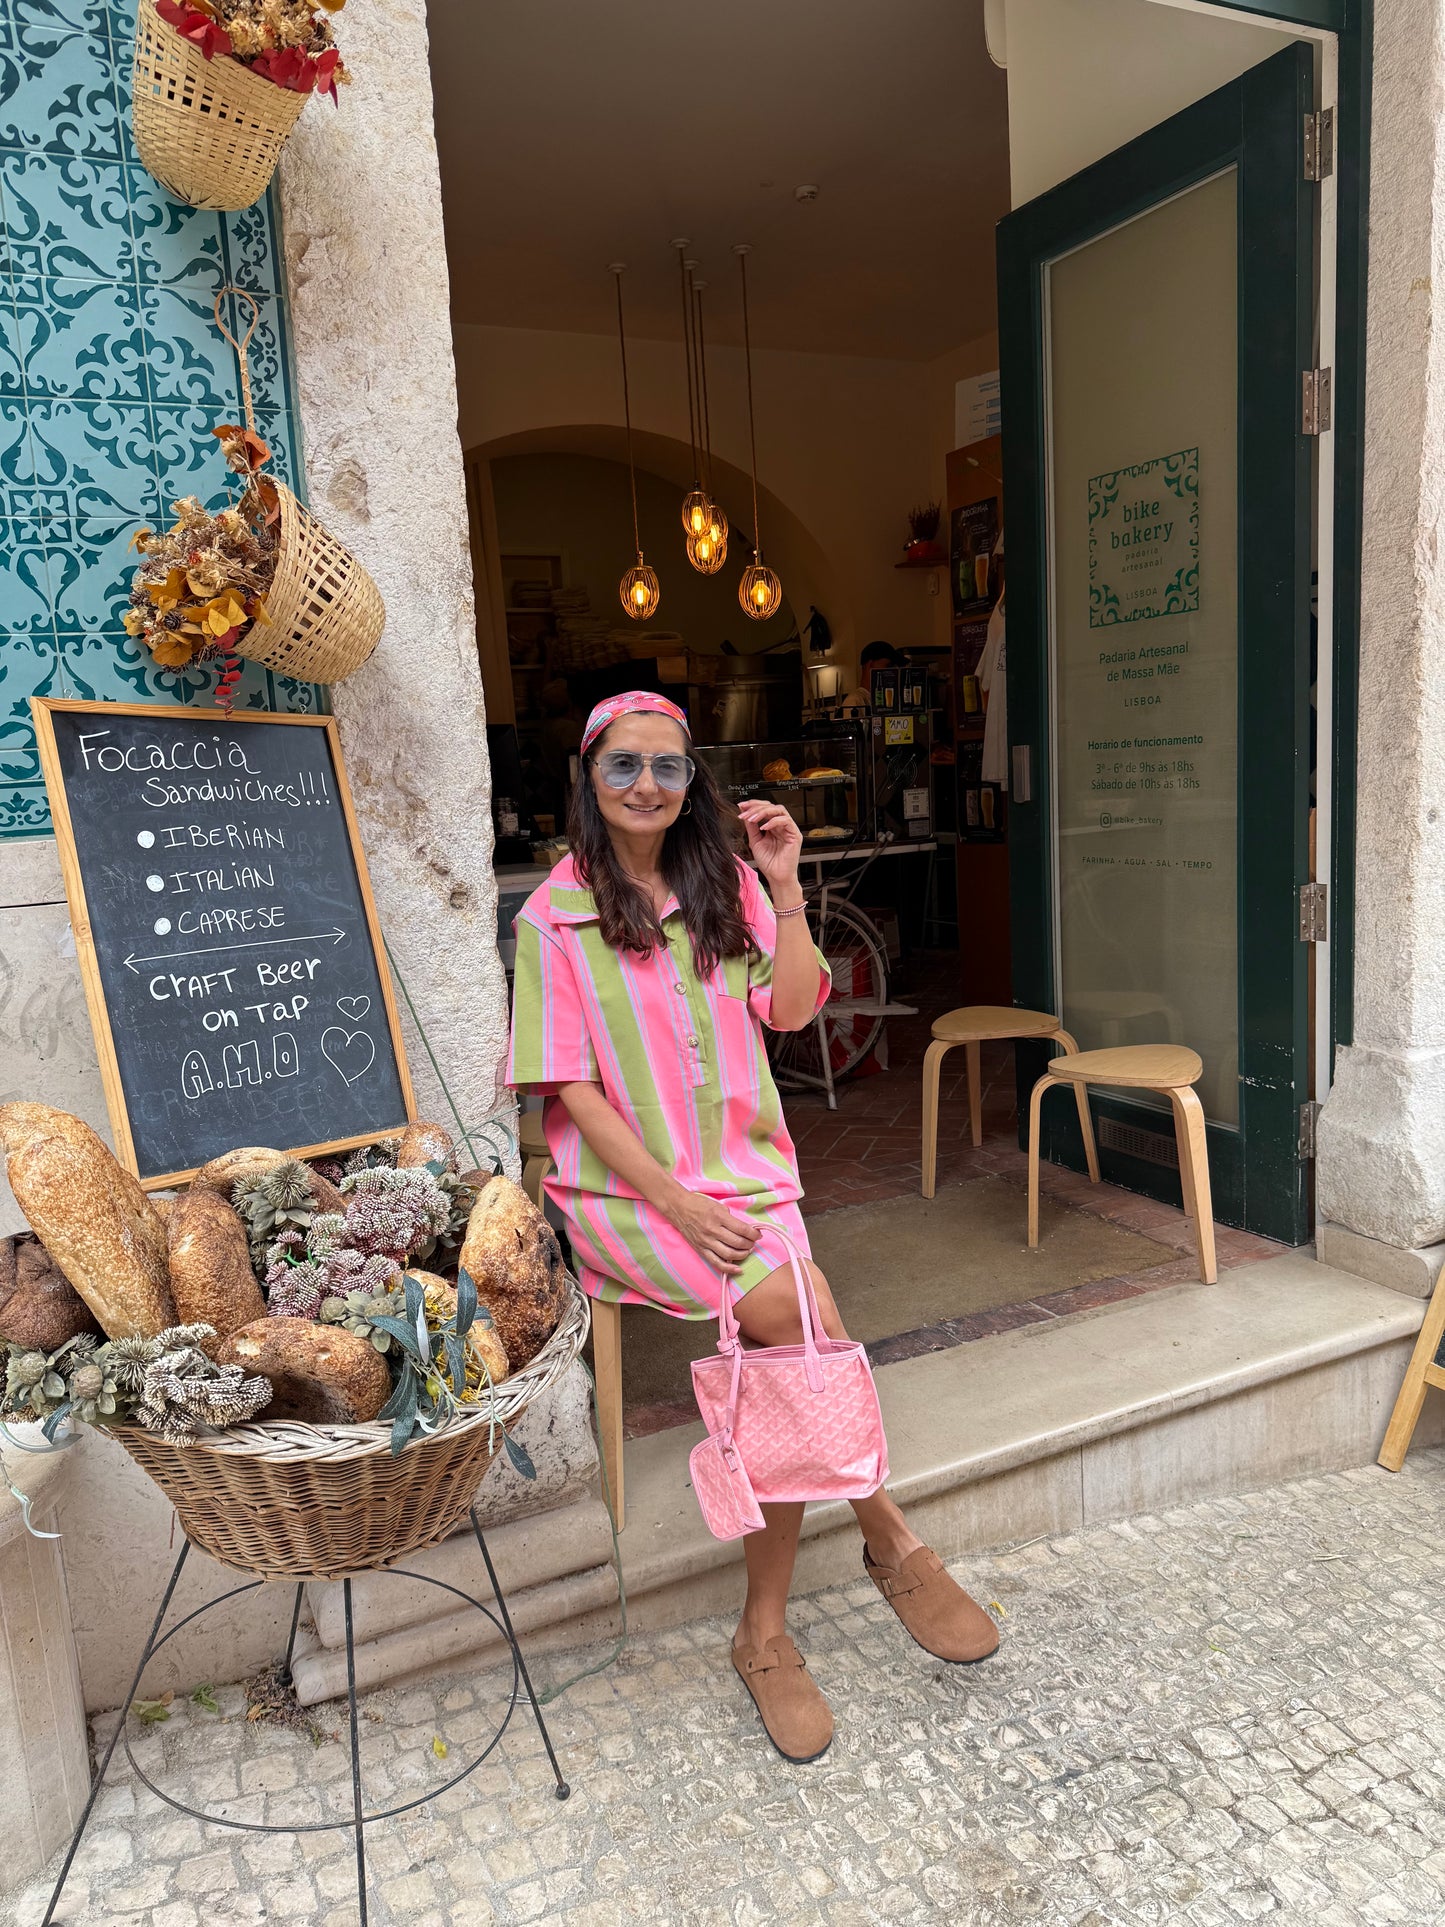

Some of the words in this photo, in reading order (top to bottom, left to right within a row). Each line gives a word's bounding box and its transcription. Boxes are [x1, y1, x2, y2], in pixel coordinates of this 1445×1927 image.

[1123, 500, 1160, 523] bike
[1111, 522, 1174, 549] bakery
[1126, 547, 1159, 561] padaria
[1121, 558, 1163, 573] artesanal
[1126, 587, 1158, 600] LISBOA
[1099, 649, 1136, 664] Padaria
[1138, 641, 1189, 660] Artesanal
[1106, 670, 1120, 682] de
[1122, 666, 1154, 680] Massa
[1157, 662, 1180, 676] Mãe
[1124, 695, 1162, 708] LISBOA
[1088, 737, 1119, 750] Horário
[1120, 738, 1132, 750] de
[1134, 734, 1204, 748] funcionamento
[79, 730, 261, 774] Focaccia
[1126, 762, 1137, 774] de
[1139, 761, 1156, 774] 9hs
[1172, 760, 1194, 772] 18hs
[142, 772, 332, 808] Sandwiches!!!
[1091, 778, 1122, 790] Sábado
[1125, 778, 1137, 790] de
[1140, 778, 1161, 790] 10hs
[1178, 776, 1200, 790] 18hs
[1082, 856, 1115, 865] FARINHA
[1156, 859, 1172, 868] SAL
[1182, 860, 1212, 870] TEMPO
[177, 906, 286, 936] CAPRESE
[256, 956, 322, 987] Beer
